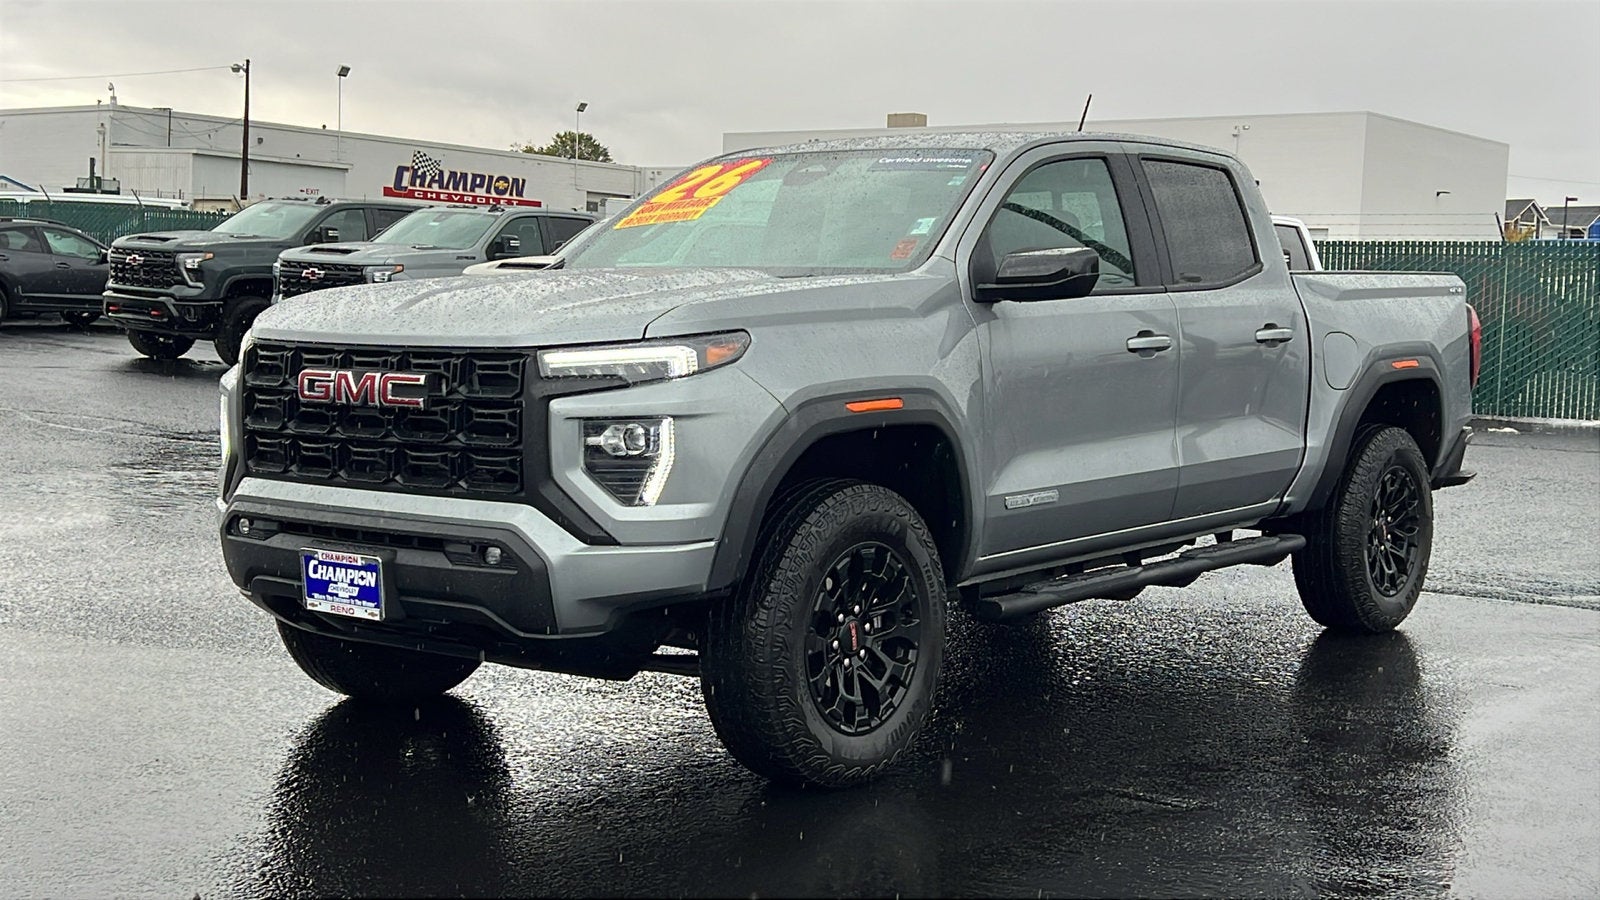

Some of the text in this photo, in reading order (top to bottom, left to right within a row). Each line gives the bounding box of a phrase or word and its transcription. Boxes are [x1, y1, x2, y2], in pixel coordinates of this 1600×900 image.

[393, 165, 527, 198] CHAMPION
[650, 160, 763, 204] 26
[414, 191, 519, 207] CHEVROLET
[298, 369, 427, 410] GMC
[321, 553, 359, 564] CHAMPION
[308, 560, 376, 587] CHAMPION
[329, 585, 358, 594] CHEVROLET
[330, 605, 355, 615] RENO
